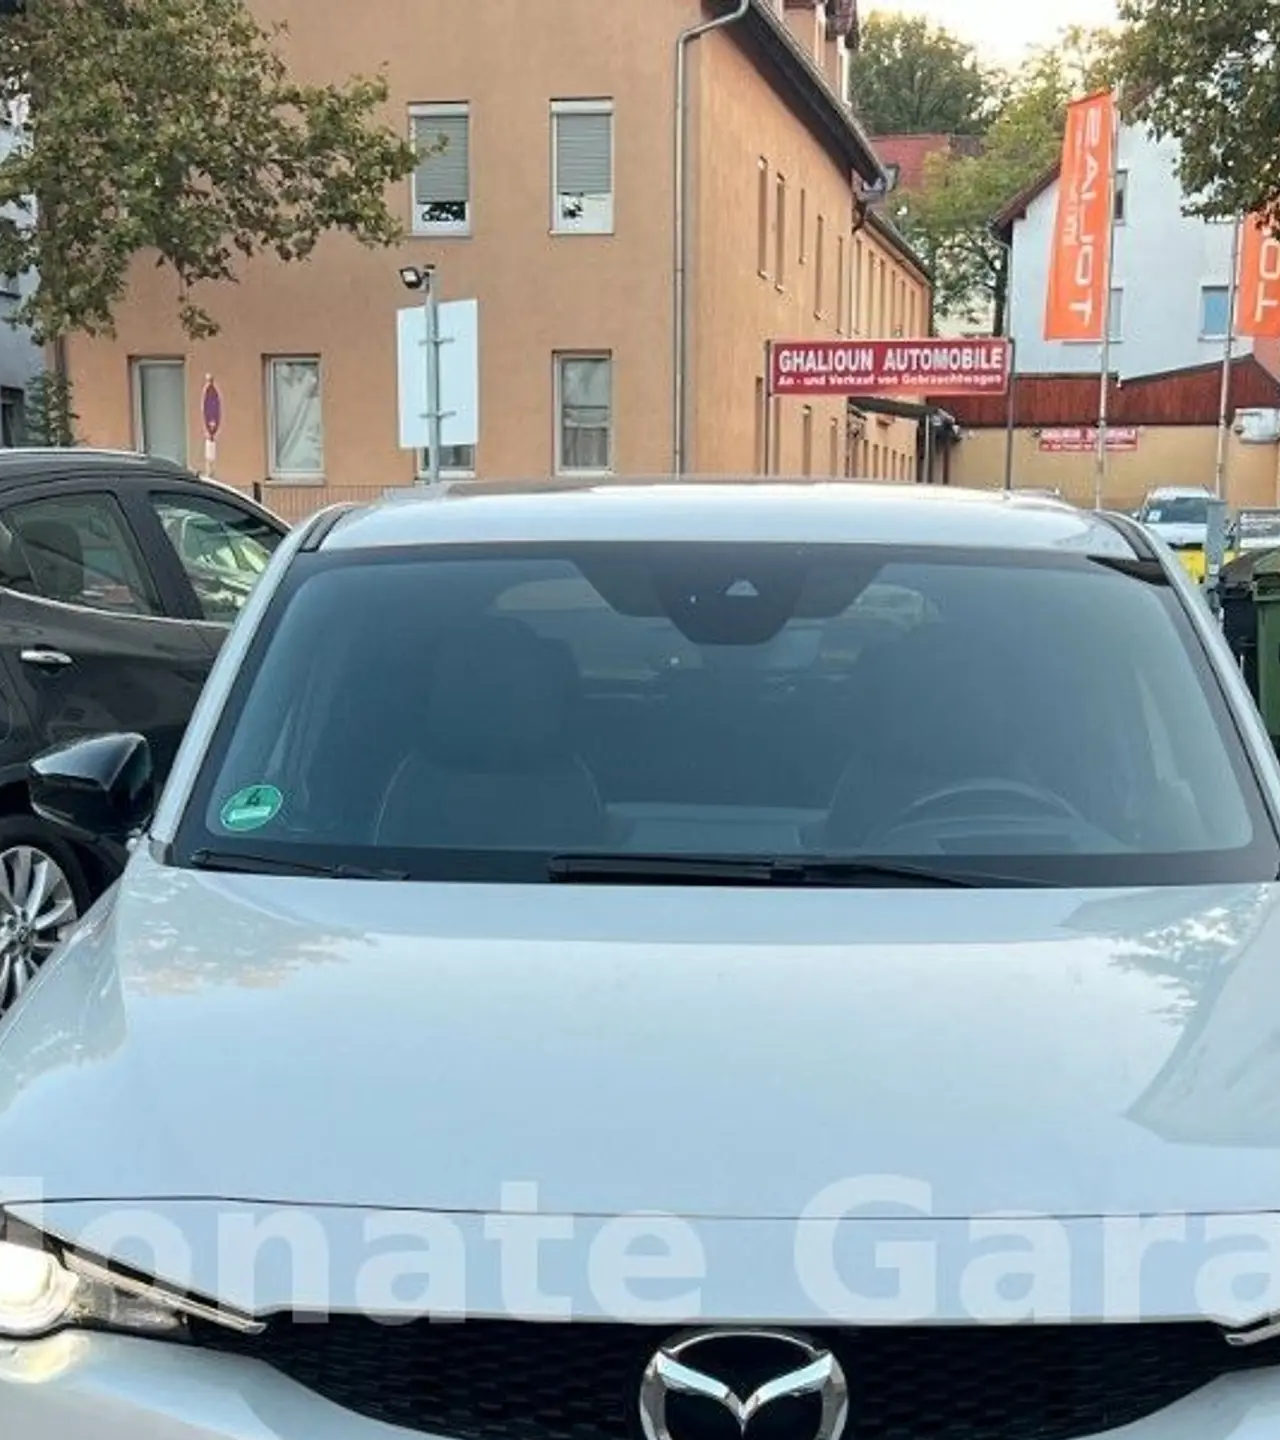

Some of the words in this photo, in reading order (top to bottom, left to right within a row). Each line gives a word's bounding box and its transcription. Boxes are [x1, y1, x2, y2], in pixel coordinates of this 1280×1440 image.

[778, 348, 874, 373] GHALIOUN
[882, 346, 1004, 371] AUTOMOBILE
[245, 787, 261, 807] 4
